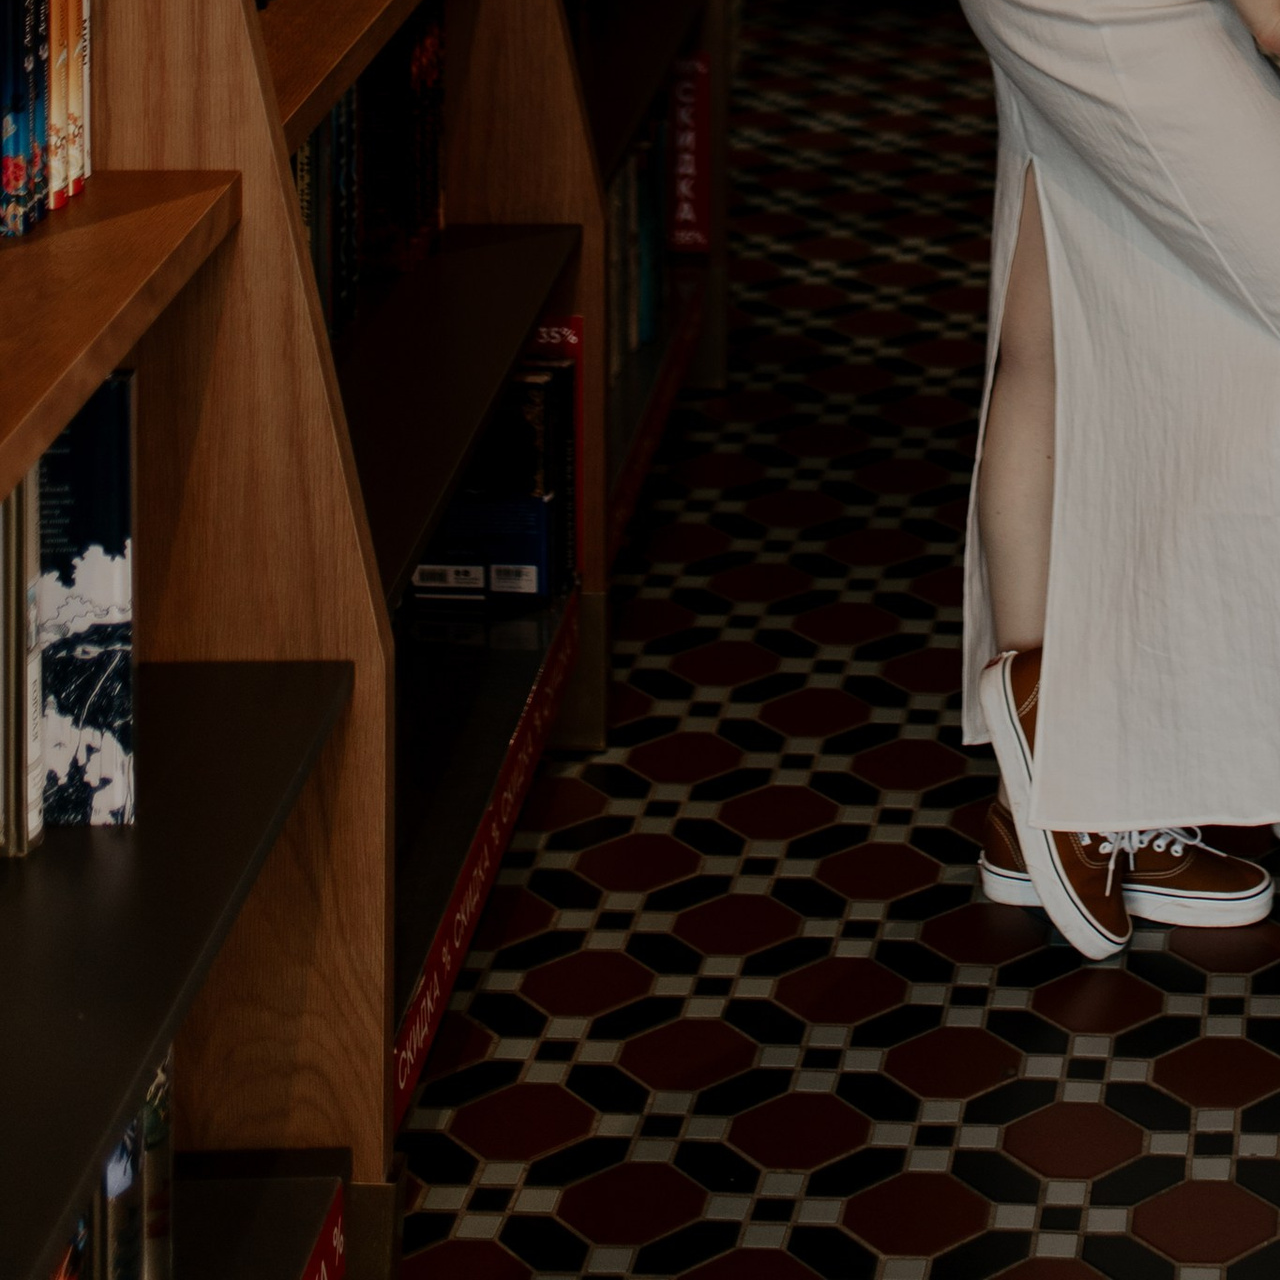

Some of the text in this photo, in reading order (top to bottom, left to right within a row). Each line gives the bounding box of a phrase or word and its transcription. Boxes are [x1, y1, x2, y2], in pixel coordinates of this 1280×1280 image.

[675, 83, 701, 229] СКИДКА
[396, 980, 441, 1092] СКИДКА
[440, 948, 452, 977] %
[452, 854, 491, 947] СКИДКА
